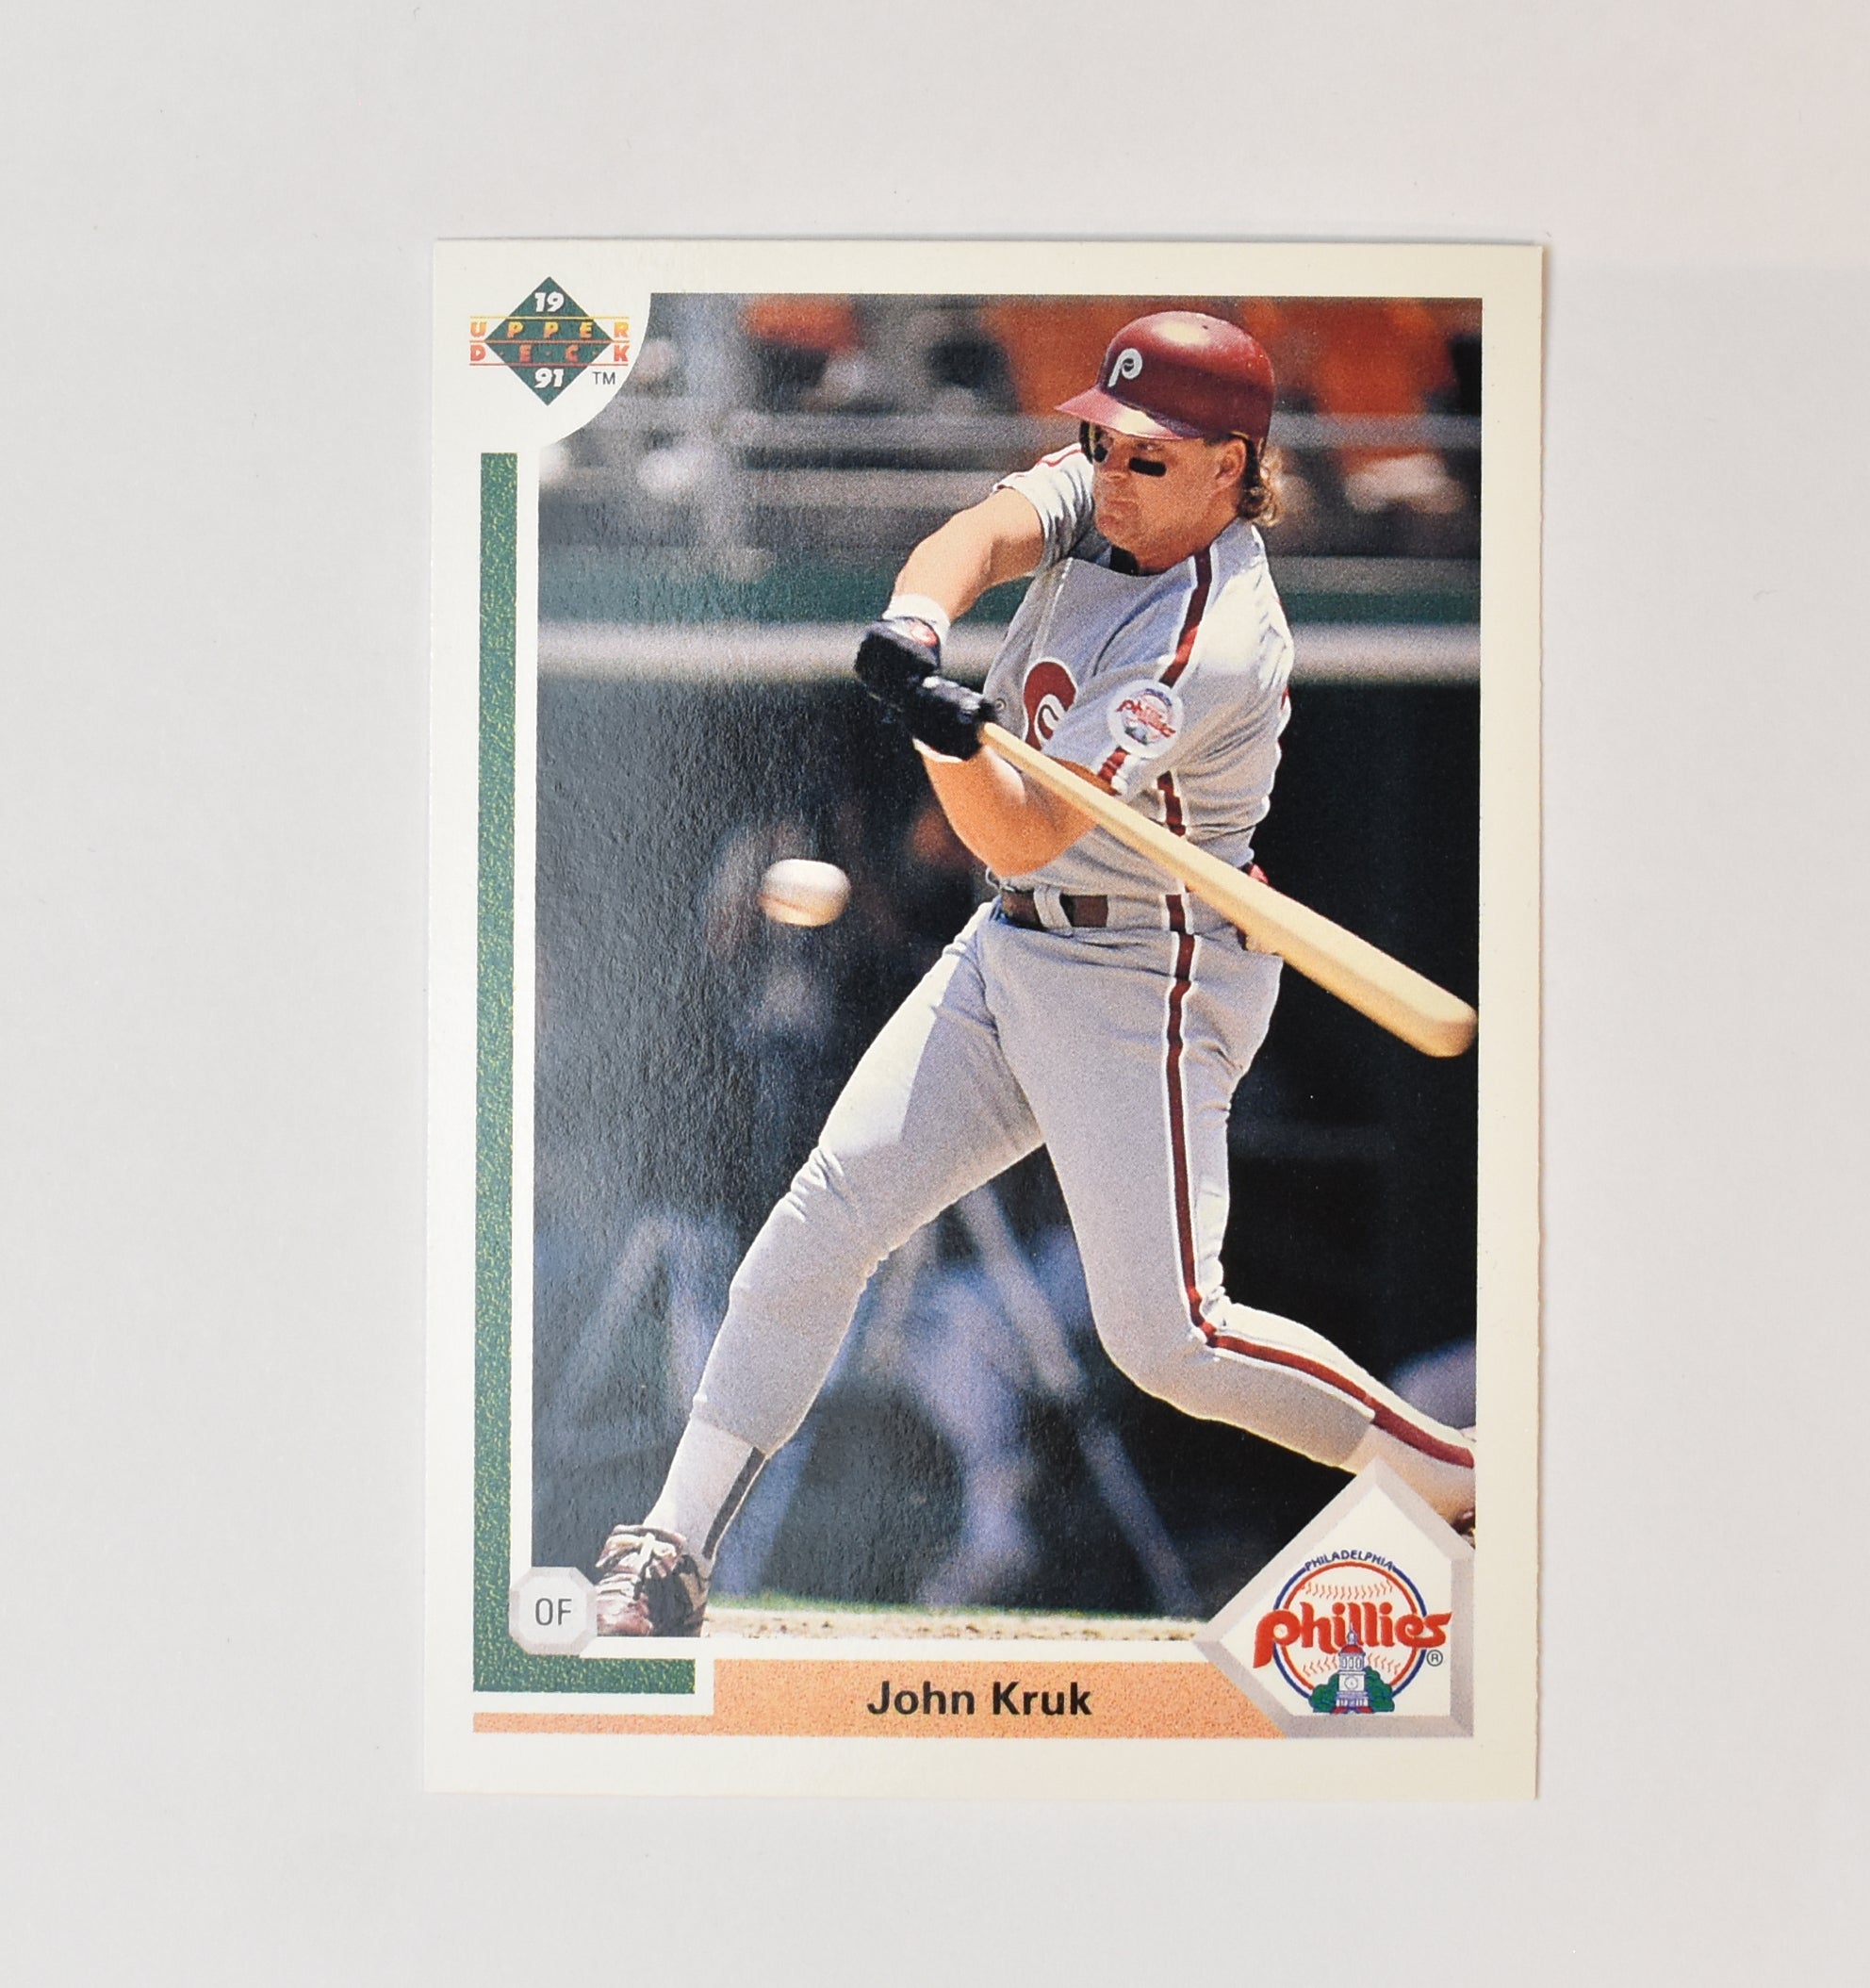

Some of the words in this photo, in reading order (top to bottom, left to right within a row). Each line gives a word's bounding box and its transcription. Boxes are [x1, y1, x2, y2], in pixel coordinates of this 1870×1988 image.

[534, 291, 565, 313] 19
[469, 321, 629, 339] UPPER
[469, 344, 629, 363] DECK
[534, 368, 565, 388] 91
[592, 371, 615, 385] TM
[1304, 1550, 1394, 1572] PHILADELPHIA
[535, 1598, 572, 1626] OF
[866, 1681, 975, 1715] John
[992, 1681, 1092, 1715] Kruk
